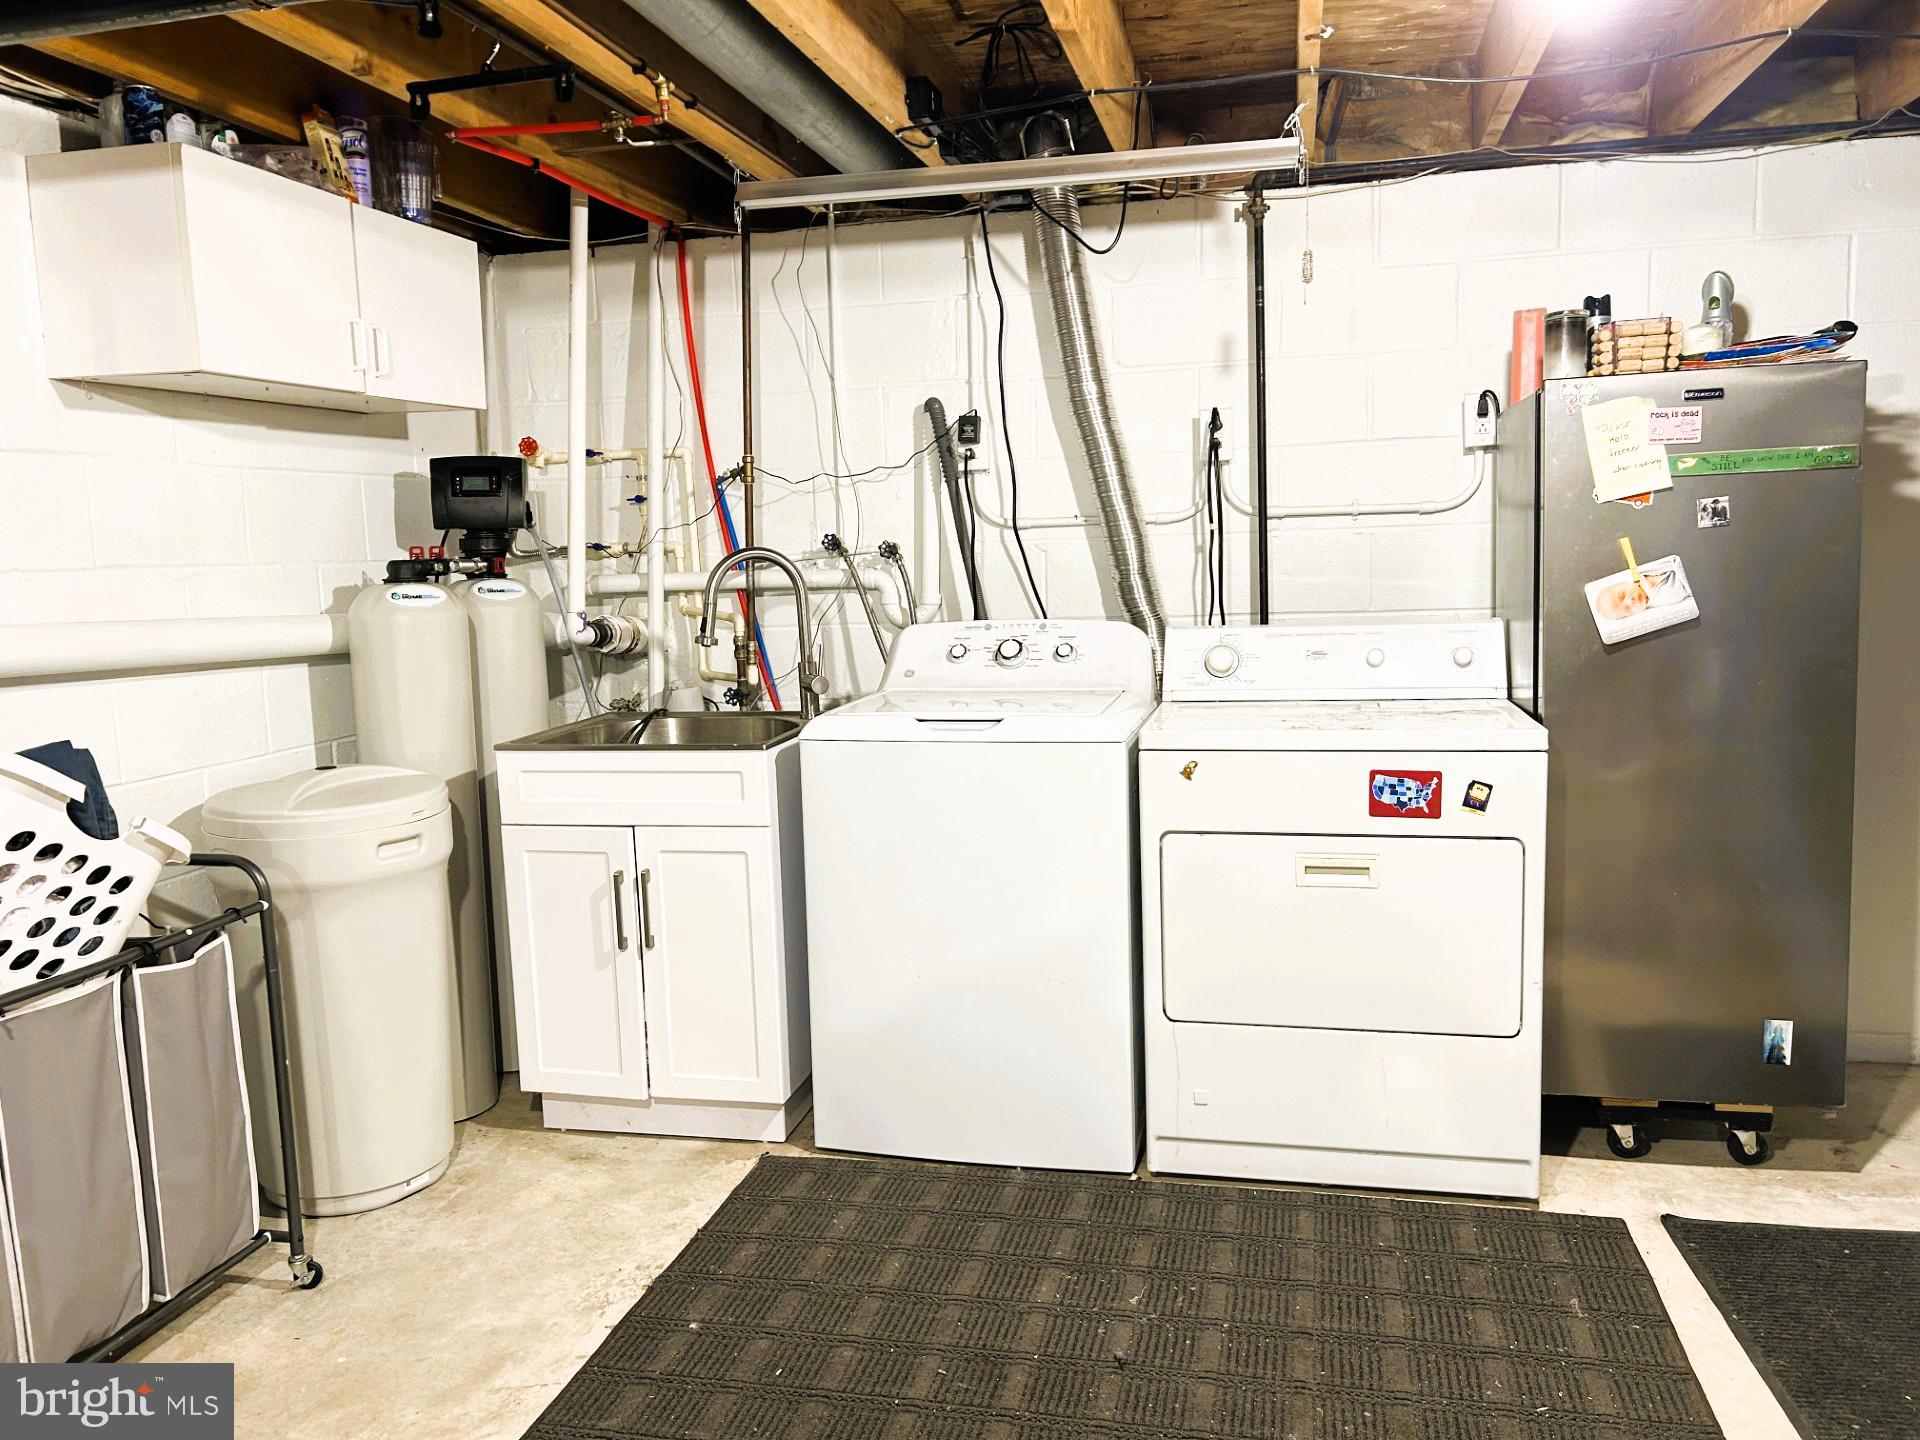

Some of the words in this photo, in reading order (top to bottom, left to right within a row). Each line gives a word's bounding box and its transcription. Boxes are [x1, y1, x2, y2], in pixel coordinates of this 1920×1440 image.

[1671, 410, 1679, 418] is
[1720, 454, 1731, 462] BE
[1813, 455, 1833, 465] GOD
[1712, 461, 1740, 471] STILL
